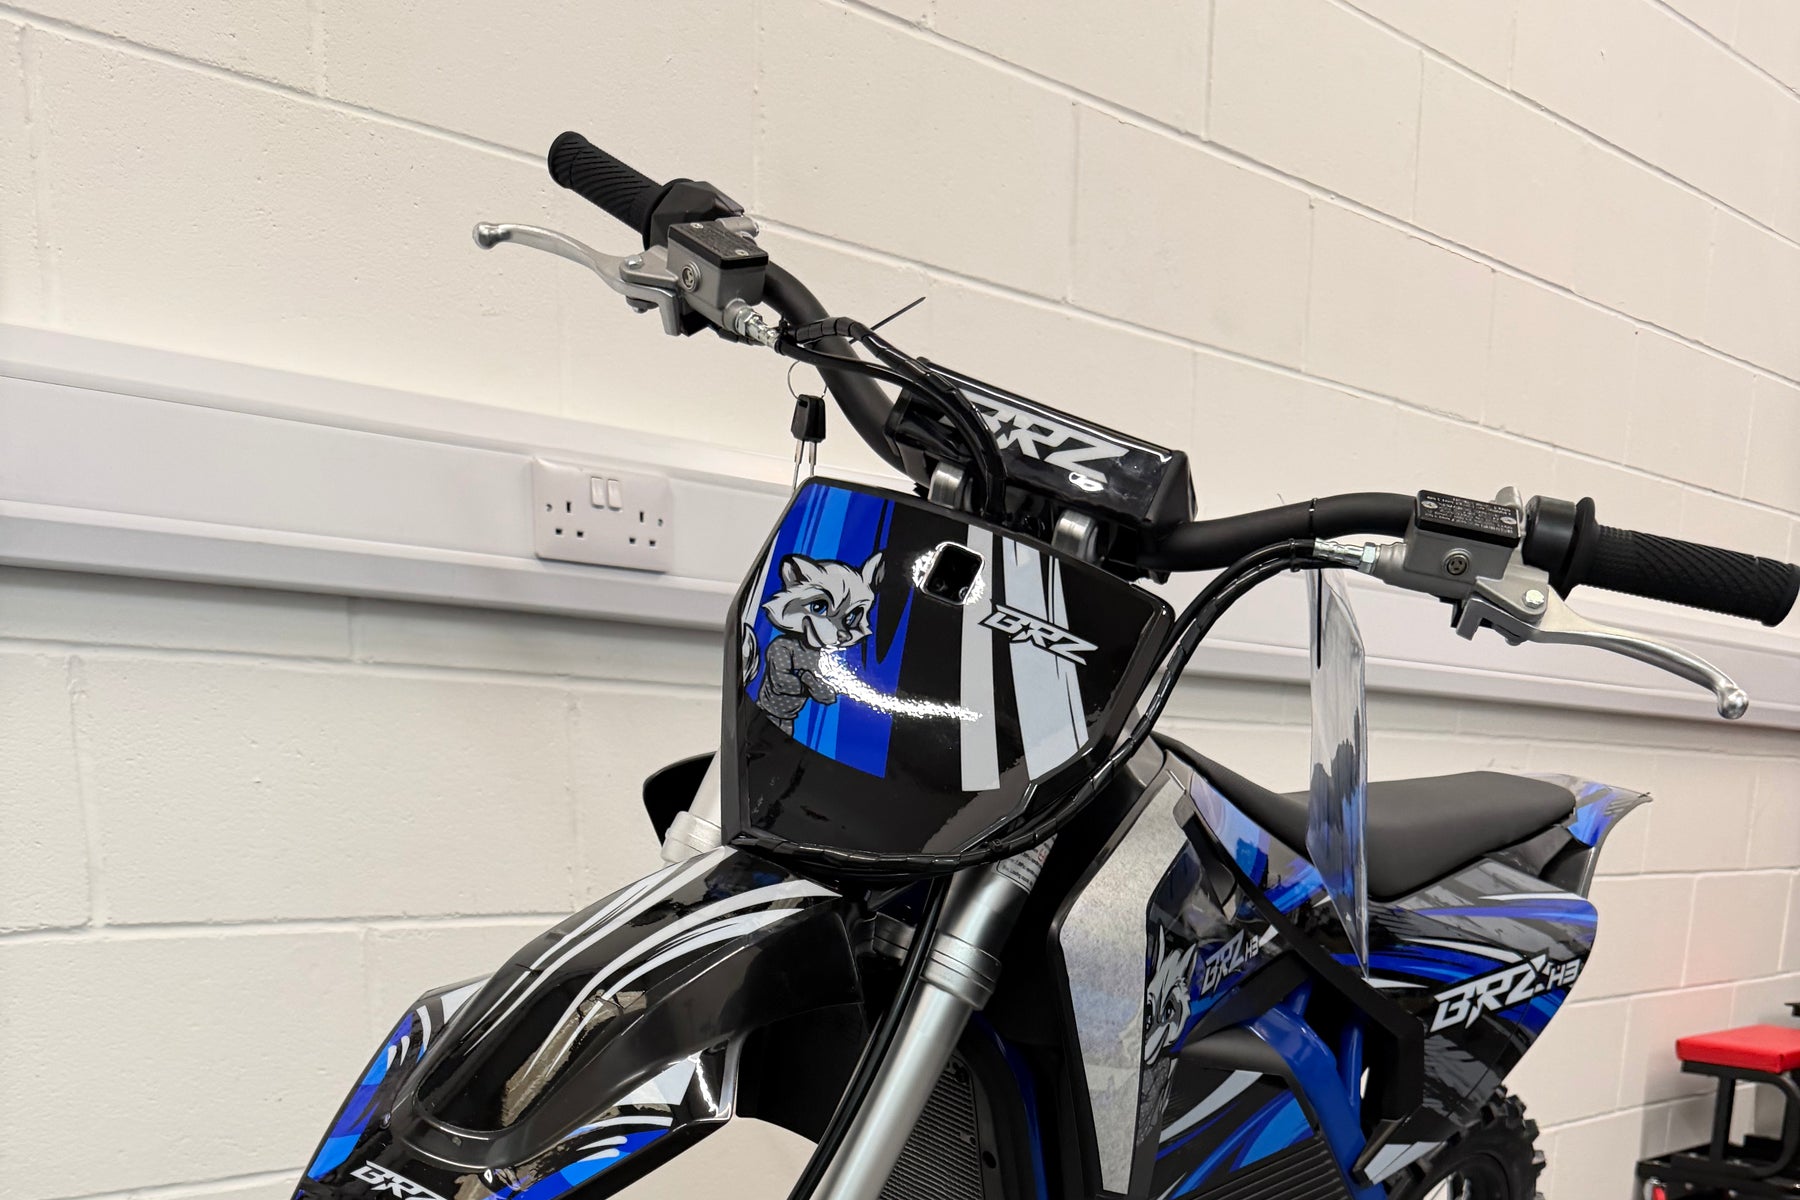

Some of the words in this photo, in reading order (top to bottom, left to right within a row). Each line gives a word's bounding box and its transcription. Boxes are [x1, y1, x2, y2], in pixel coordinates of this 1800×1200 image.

[983, 604, 1099, 665] BRZ
[1201, 929, 1244, 993] BRZ
[1244, 935, 1259, 962] H3
[1430, 954, 1546, 1033] BRZ
[1546, 959, 1580, 990] H3
